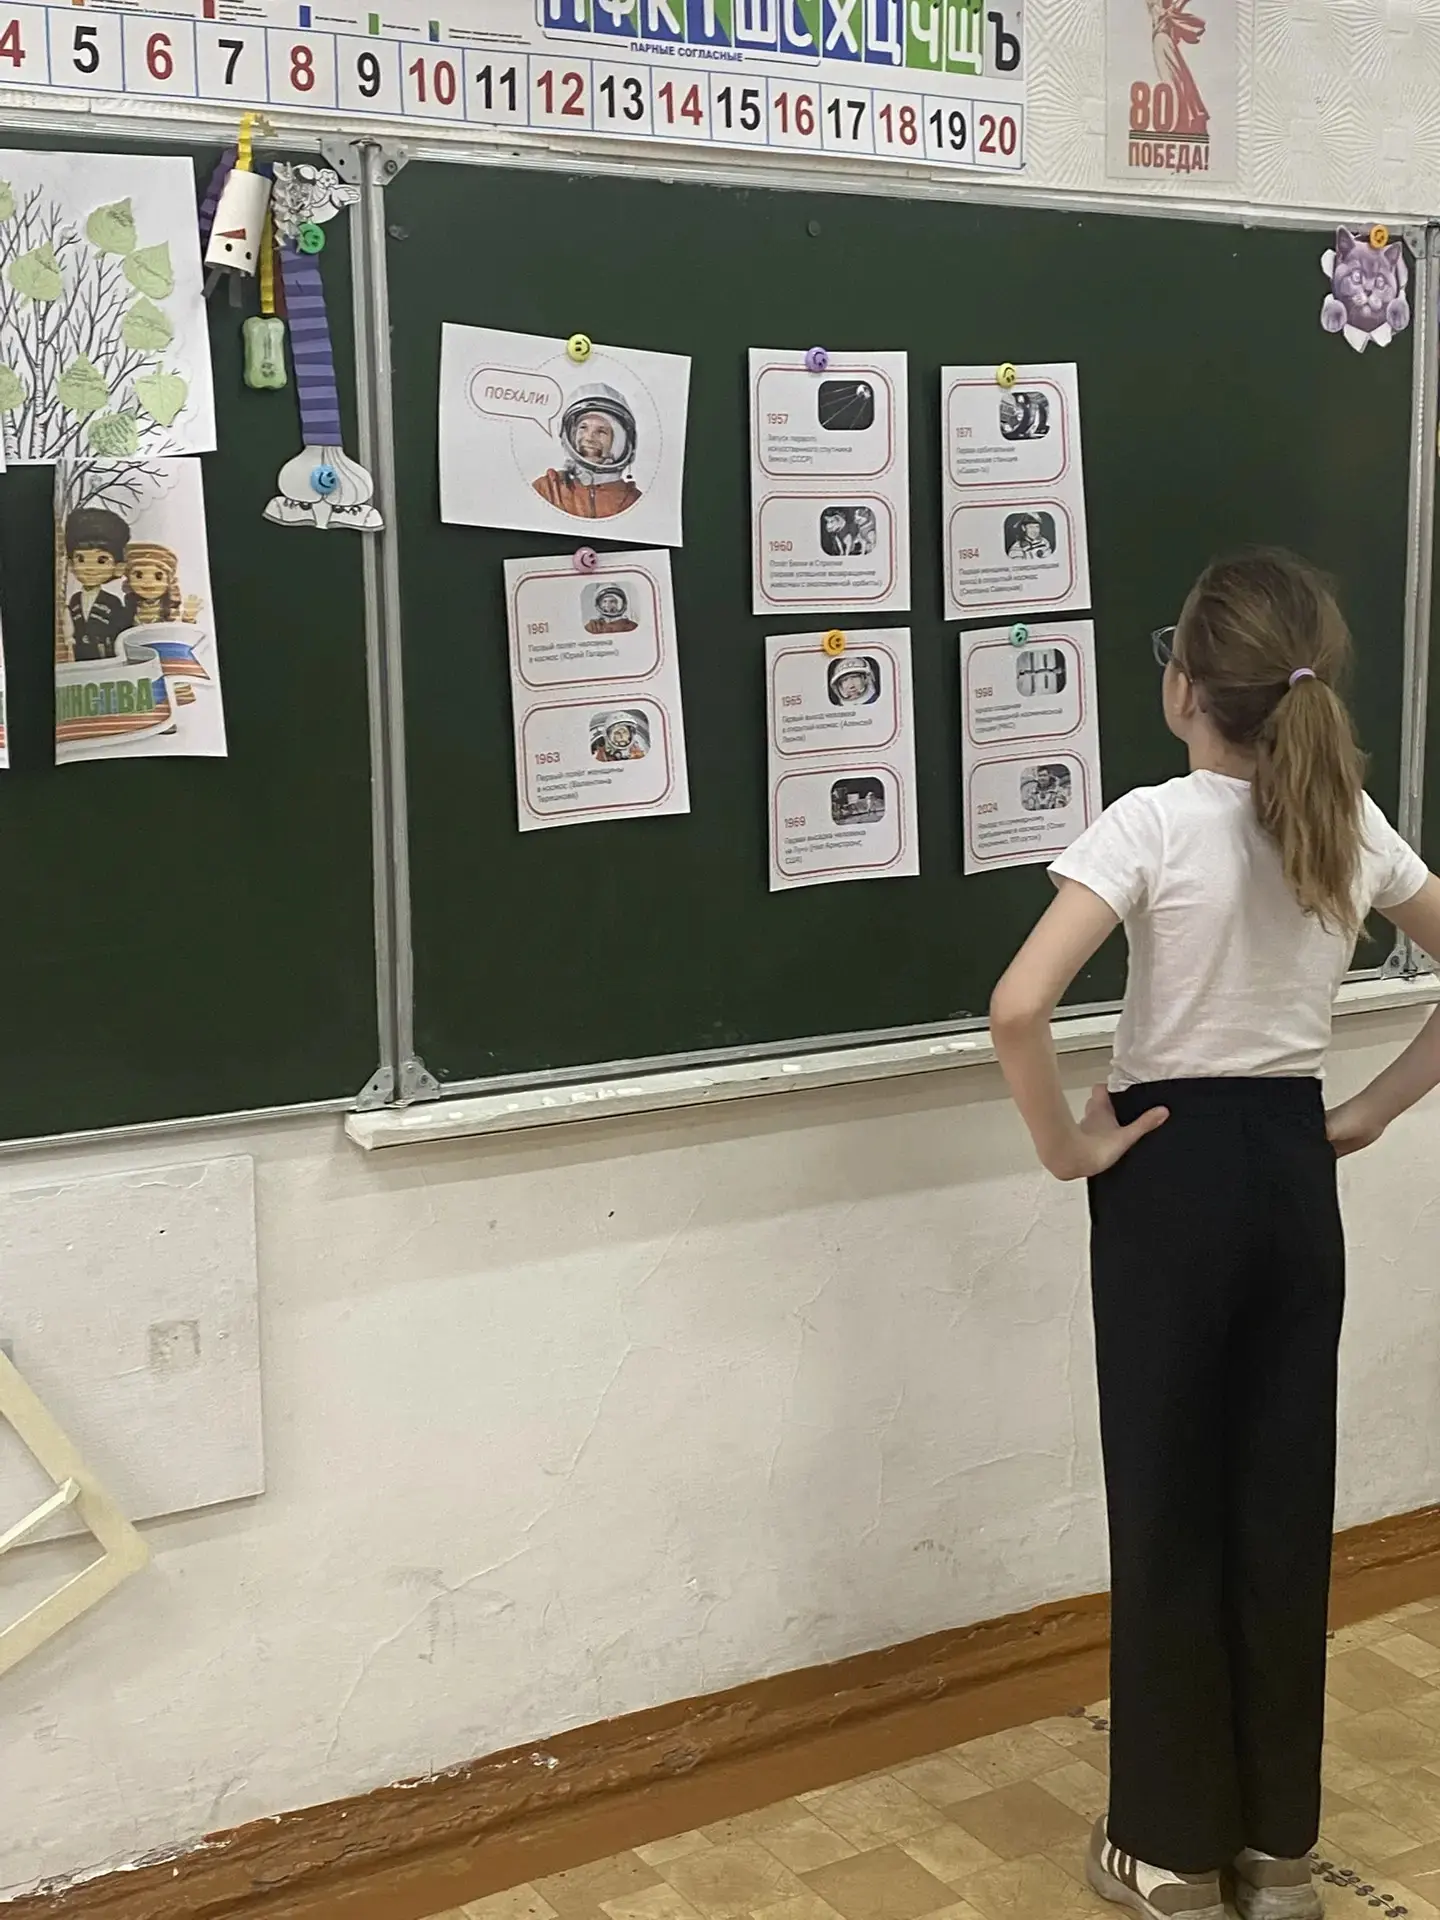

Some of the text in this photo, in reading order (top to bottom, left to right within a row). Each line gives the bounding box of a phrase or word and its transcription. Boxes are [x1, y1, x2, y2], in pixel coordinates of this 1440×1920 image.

[867, 0, 901, 65] Ц
[911, 1, 939, 63] Ч
[949, 6, 982, 75] Щ
[987, 11, 1021, 71] Ъ
[630, 42, 743, 62] ПАРНЫЕ СОГЛАСНЫЕ
[0, 19, 1017, 157] 4 5 6 7 8 9 10 11 12 13 14 15 16 17 18 19 20
[1129, 80, 1176, 133] 80
[1128, 141, 1210, 175] ПОБЕДА!
[485, 386, 549, 406] ПОЕХАЛИ!
[767, 413, 789, 424] 1957
[769, 541, 793, 552] 1960
[527, 621, 549, 636] 1961
[534, 751, 561, 765] 1963
[784, 816, 806, 829] 1969
